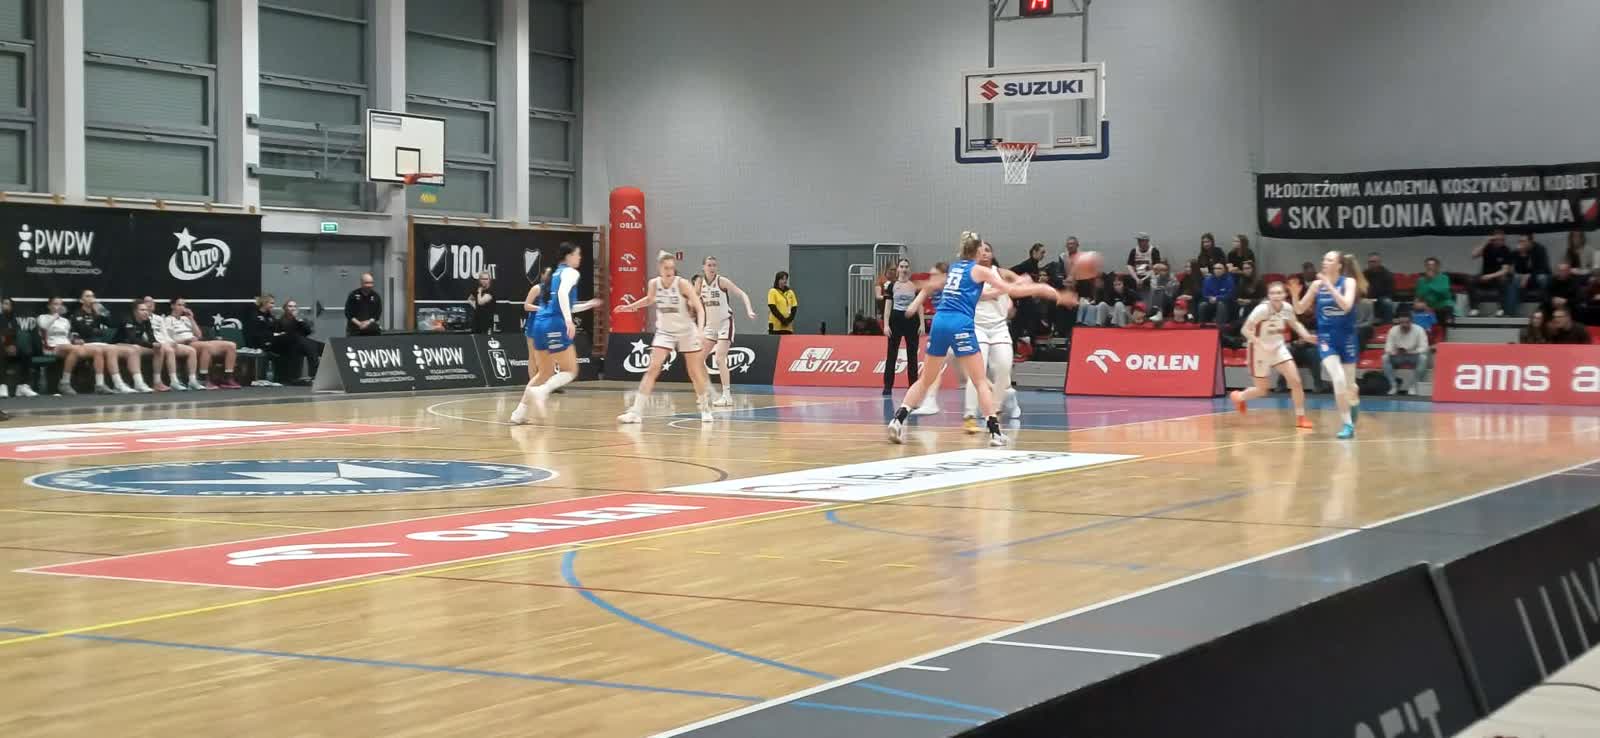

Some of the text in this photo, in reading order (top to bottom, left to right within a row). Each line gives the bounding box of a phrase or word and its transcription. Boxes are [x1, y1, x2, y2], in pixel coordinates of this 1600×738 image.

[1004, 80, 1083, 97] SUZUKI
[1264, 173, 1600, 198] MŁODZIEŻOWA AKADEMIA KOSZYKÓWKI KOBIET
[1288, 199, 1575, 229] SKK POLONIA WARSZAWA
[34, 229, 94, 256] PWPW
[182, 246, 219, 272] LOTTO
[450, 244, 484, 279] 100
[357, 349, 401, 369] PWPW
[423, 347, 464, 366] PWPW
[1125, 354, 1200, 371] ORLEN
[1454, 364, 1550, 392] ams
[404, 503, 707, 541] ORLEN
